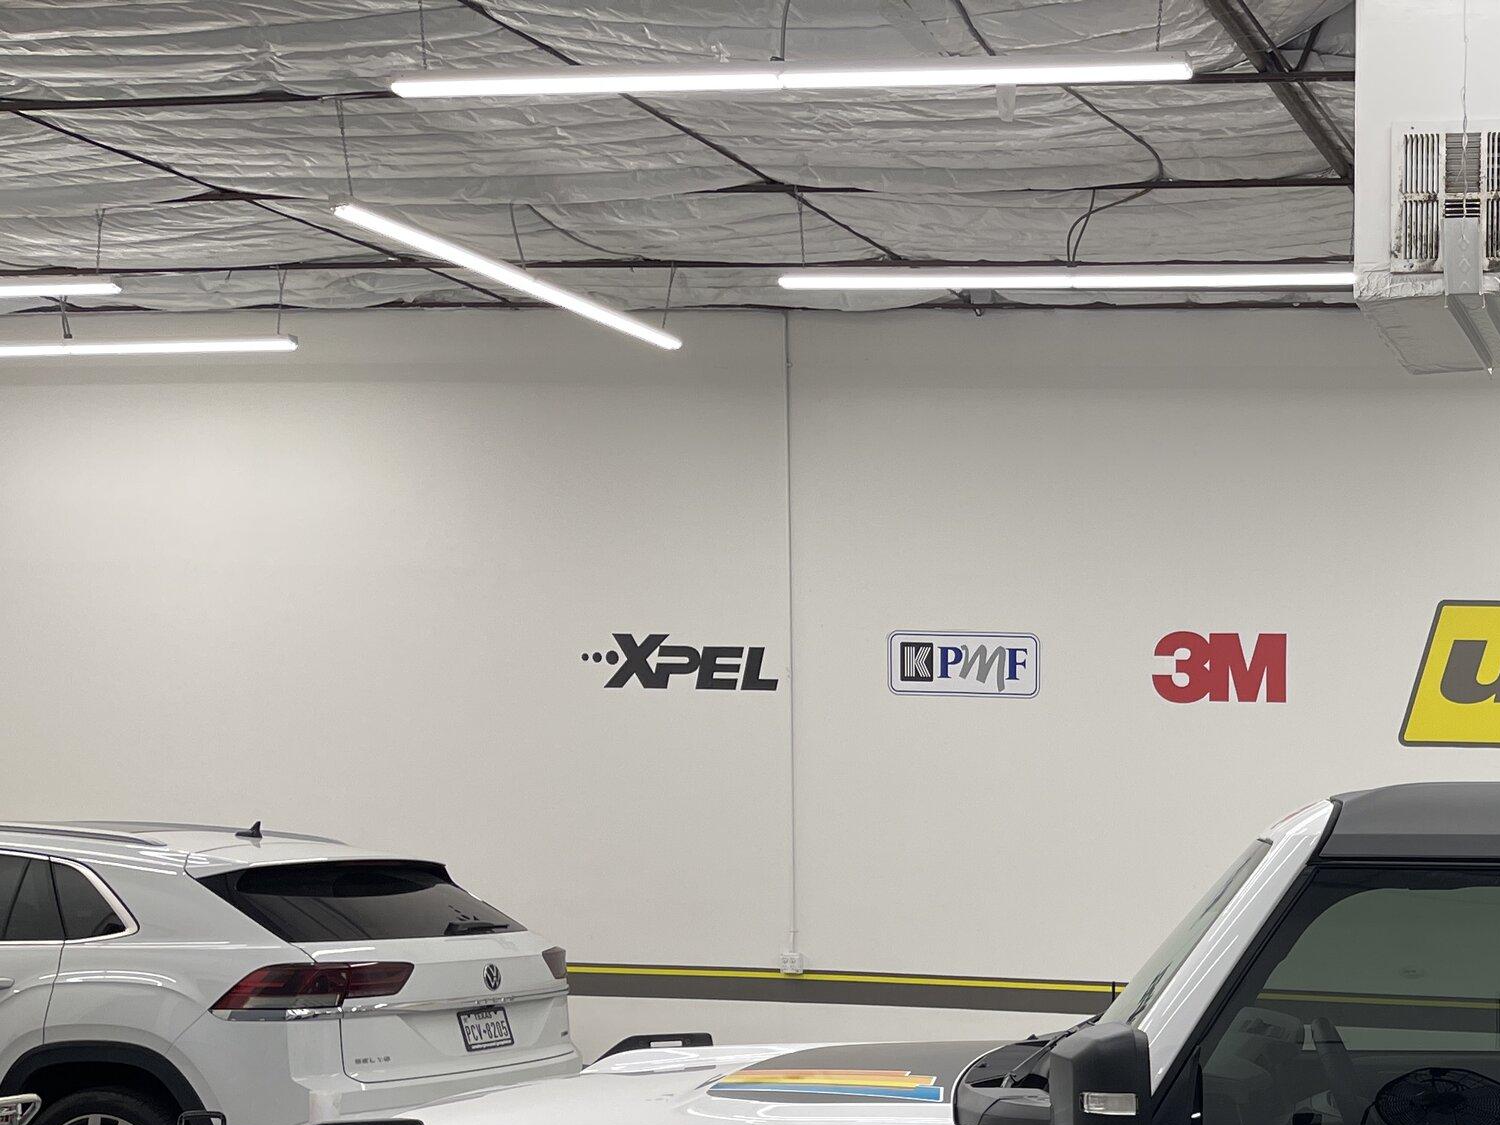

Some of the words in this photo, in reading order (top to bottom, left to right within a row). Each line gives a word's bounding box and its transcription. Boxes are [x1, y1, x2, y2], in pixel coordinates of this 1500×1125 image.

[603, 633, 779, 691] XPEL
[900, 641, 1029, 693] KPMF
[1152, 631, 1287, 703] 3M
